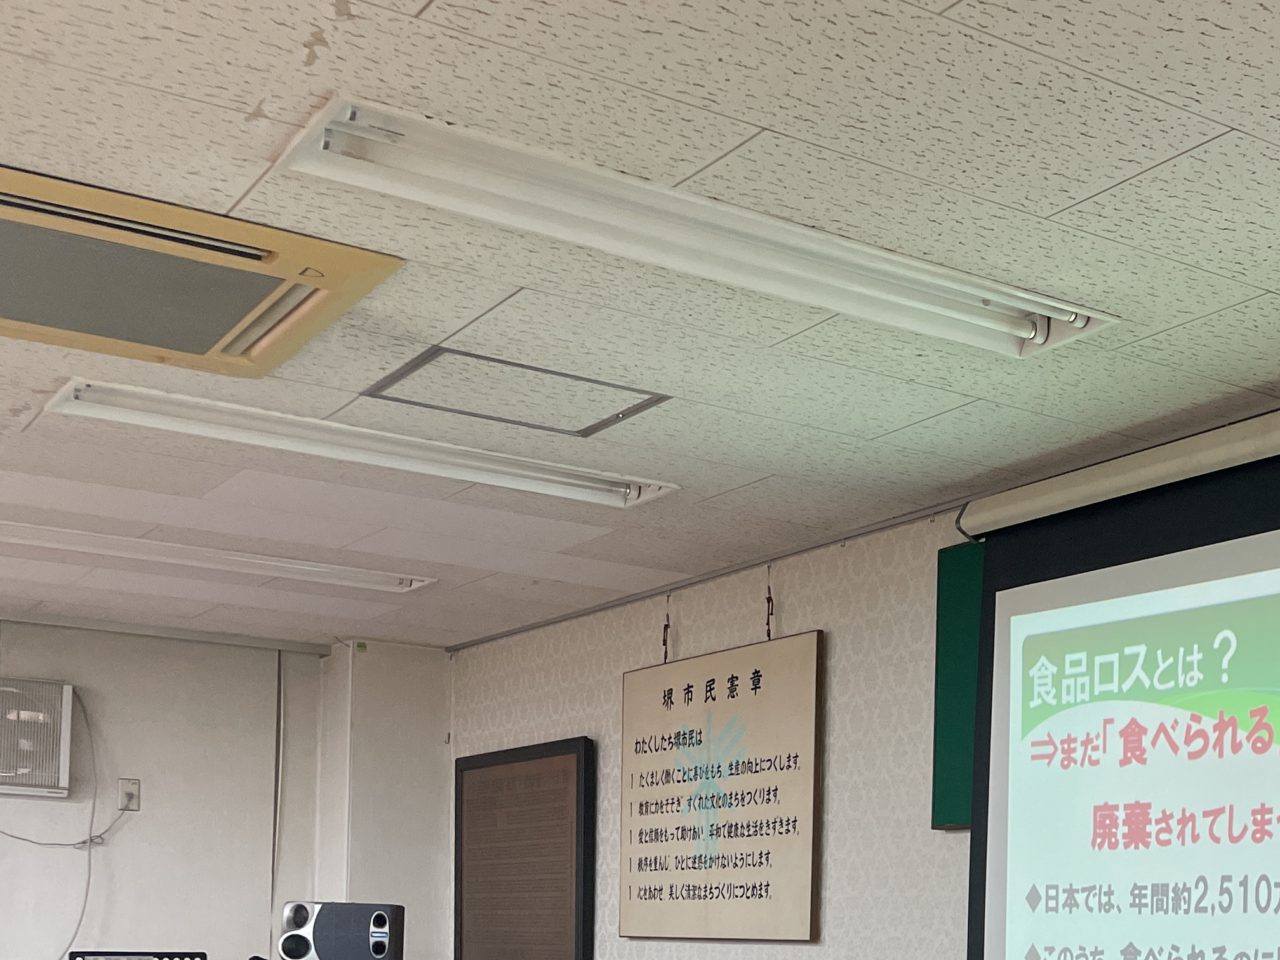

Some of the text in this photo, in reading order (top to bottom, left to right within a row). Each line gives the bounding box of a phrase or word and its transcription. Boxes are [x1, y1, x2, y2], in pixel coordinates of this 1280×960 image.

[662, 668, 763, 711] 堺市民憲章
[1028, 629, 1237, 709] 食品ロスとは？
[634, 728, 703, 755] わたくしたち堺市民は
